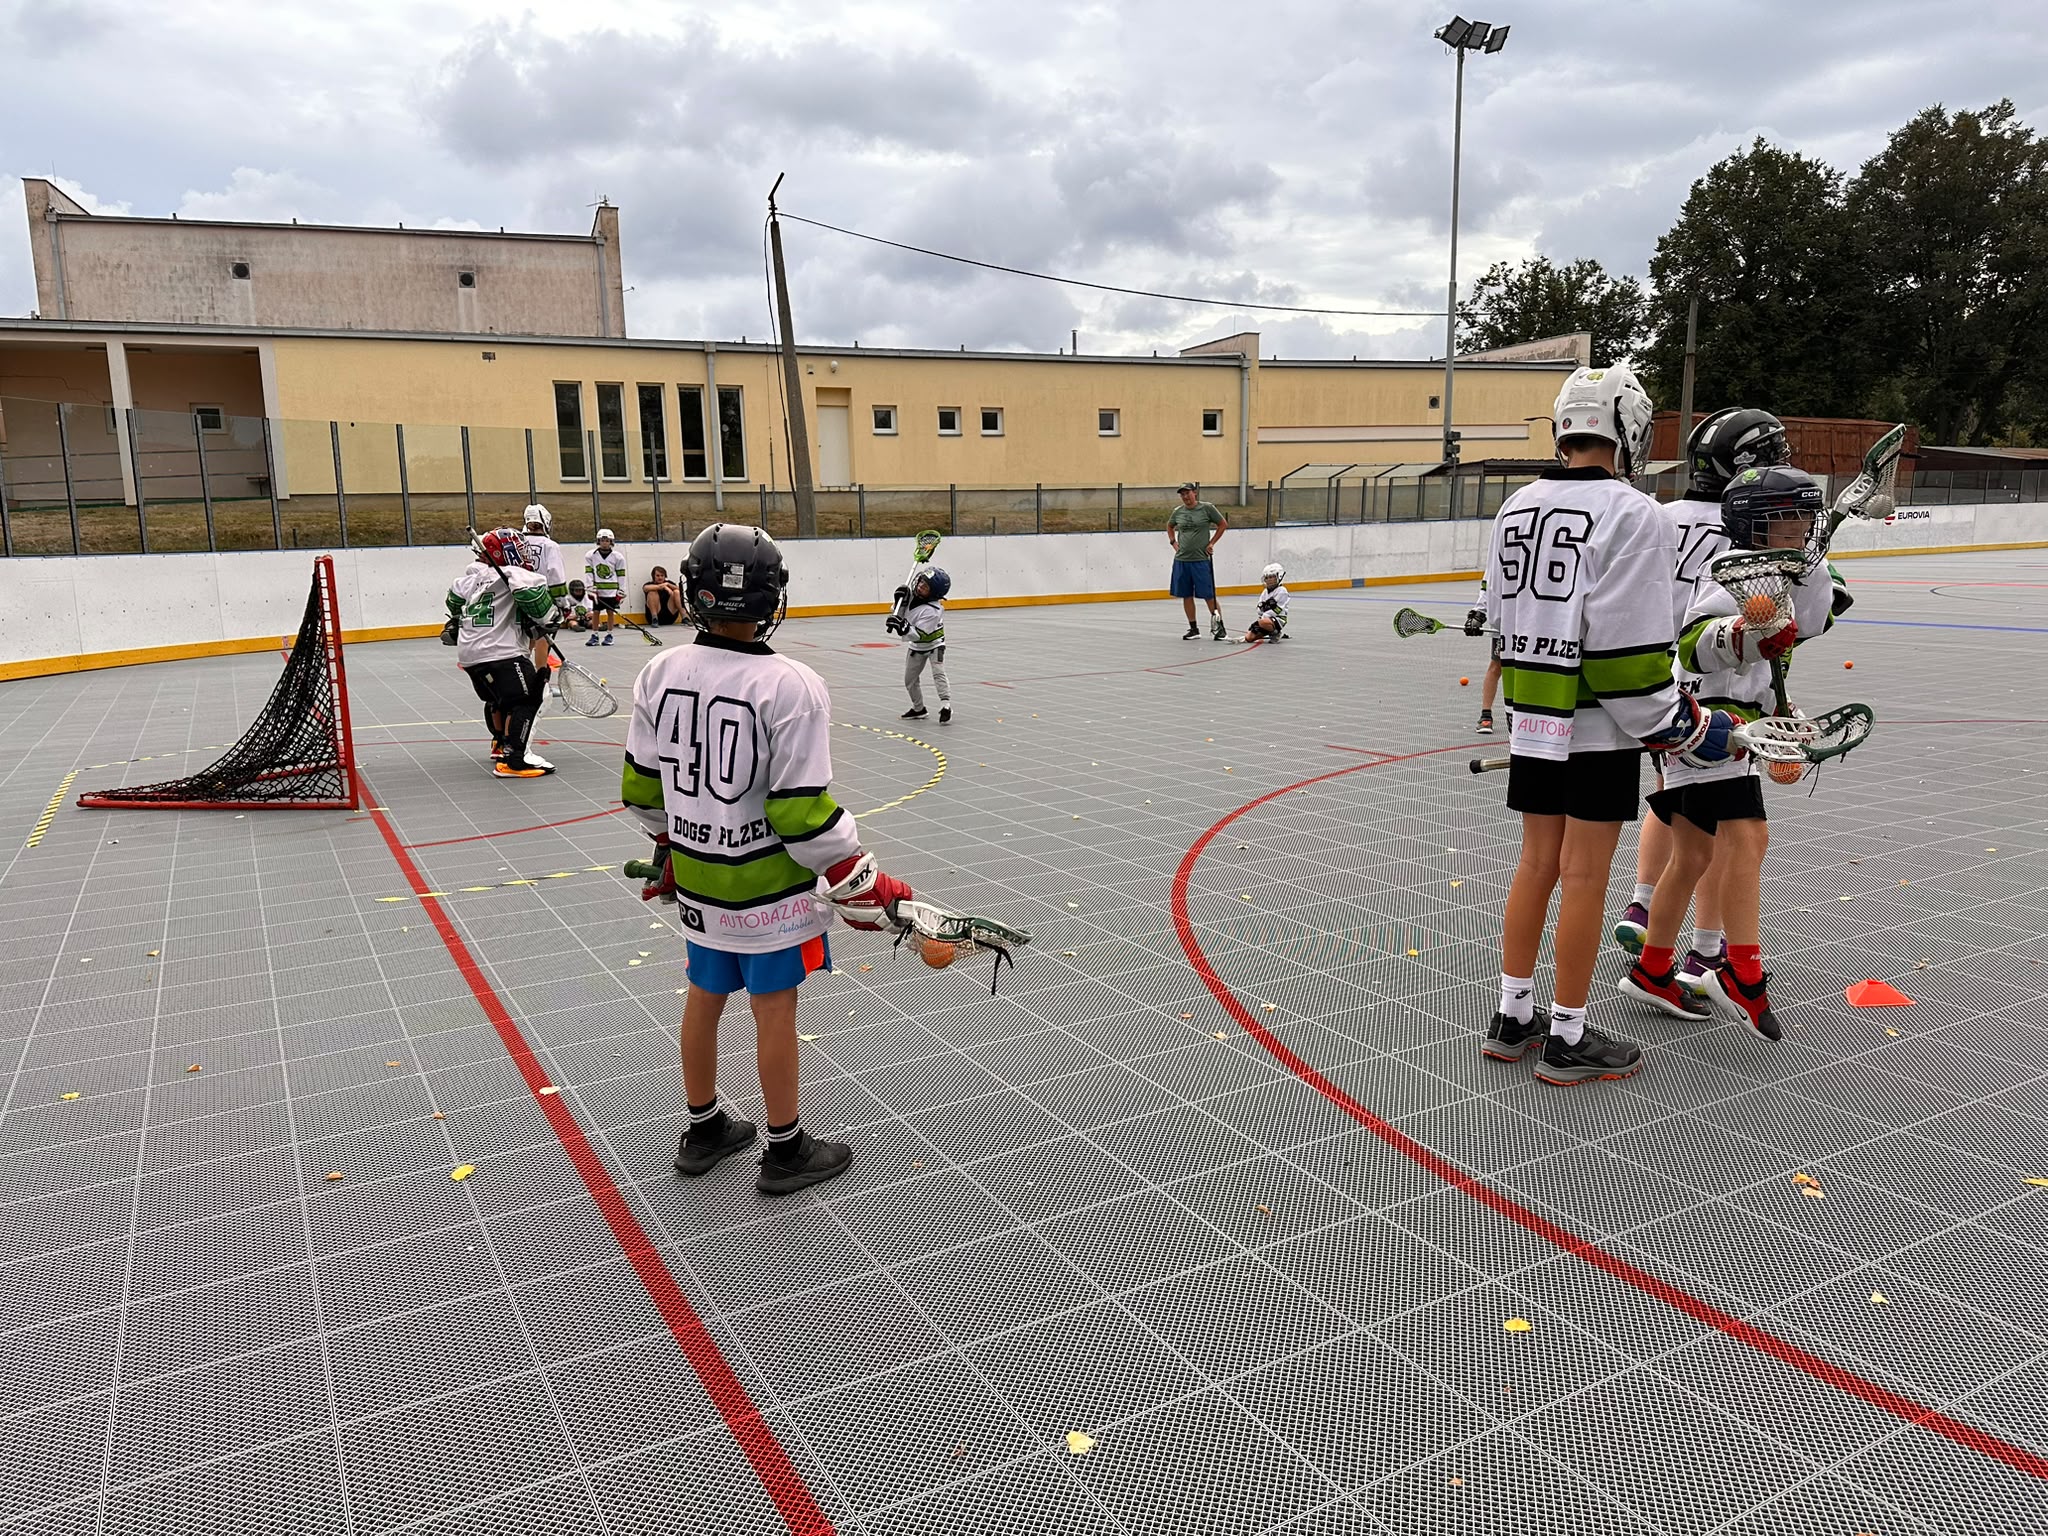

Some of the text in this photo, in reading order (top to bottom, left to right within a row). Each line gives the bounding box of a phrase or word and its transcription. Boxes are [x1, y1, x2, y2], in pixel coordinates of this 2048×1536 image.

[1800, 490, 1821, 498] CCM
[1897, 510, 1930, 520] EUROVIA
[1499, 506, 1594, 603] 56
[717, 601, 747, 609] BAUER
[1715, 624, 1728, 650] STX
[655, 688, 760, 806] 40
[1686, 715, 1710, 751] ARMOUR
[673, 815, 712, 845] DOGS
[848, 863, 873, 891] STX
[719, 898, 812, 930] AUTOBAZAR
